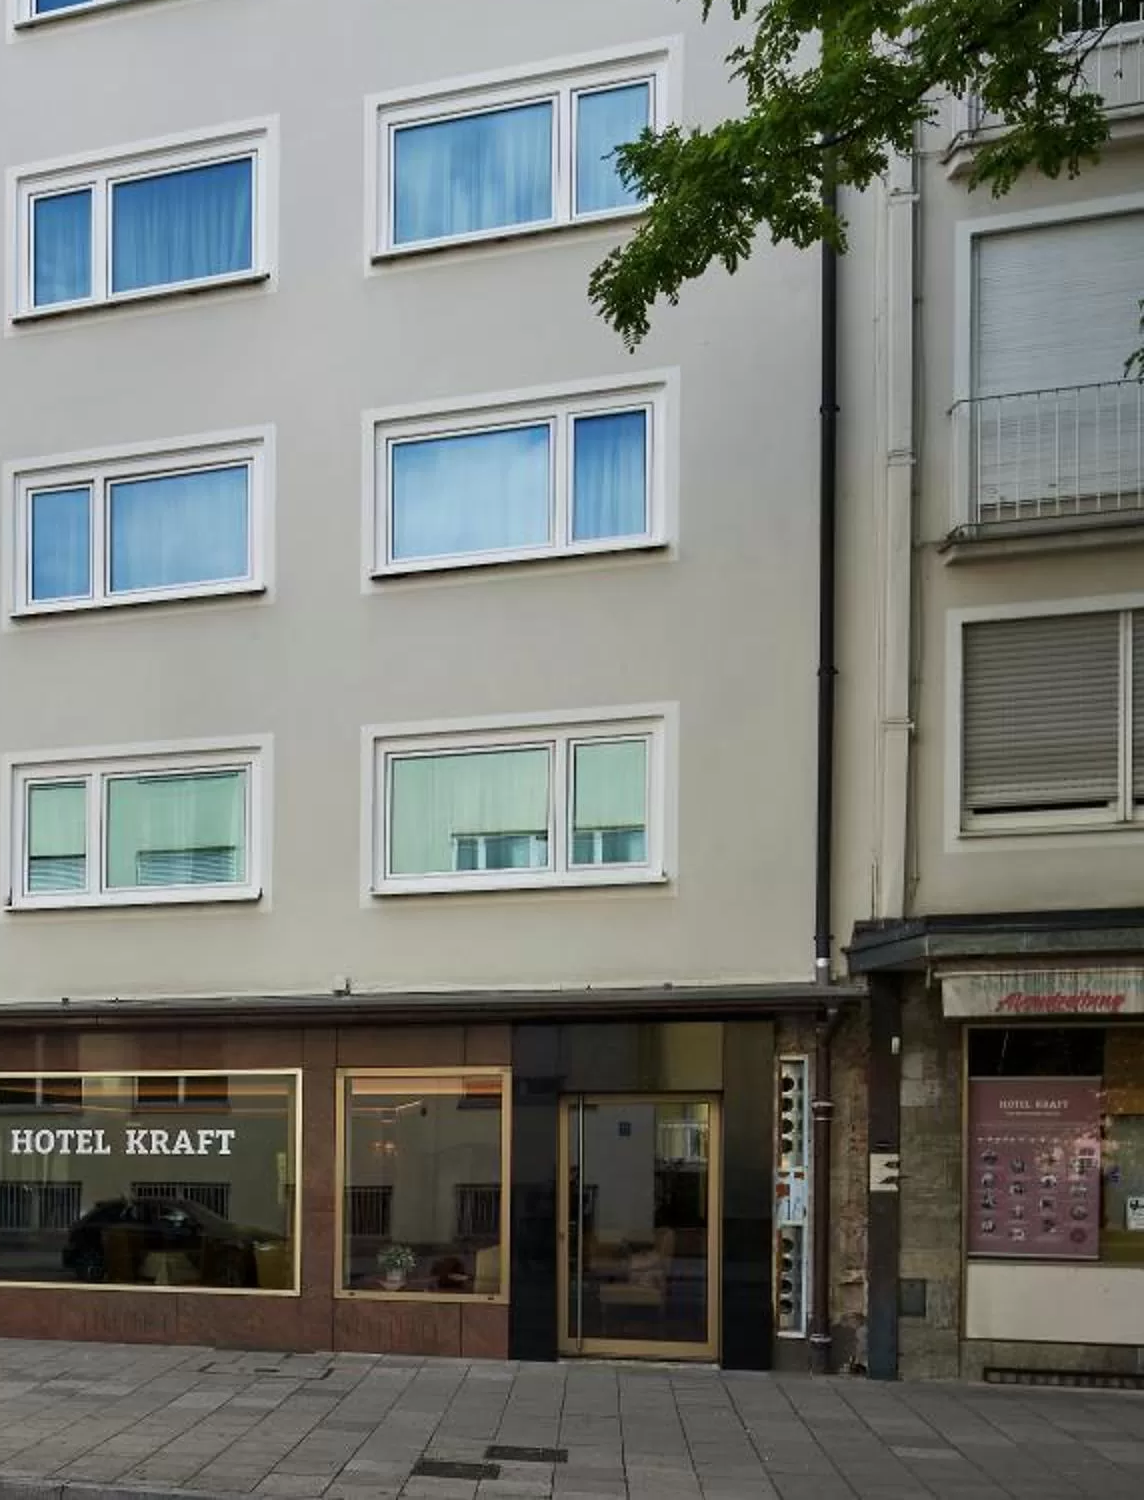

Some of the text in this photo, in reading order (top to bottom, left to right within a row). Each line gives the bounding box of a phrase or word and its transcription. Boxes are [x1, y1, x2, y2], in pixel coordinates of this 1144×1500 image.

[999, 1099, 1030, 1109] HOTEL
[11, 1129, 236, 1155] HOTEL KRAFT
